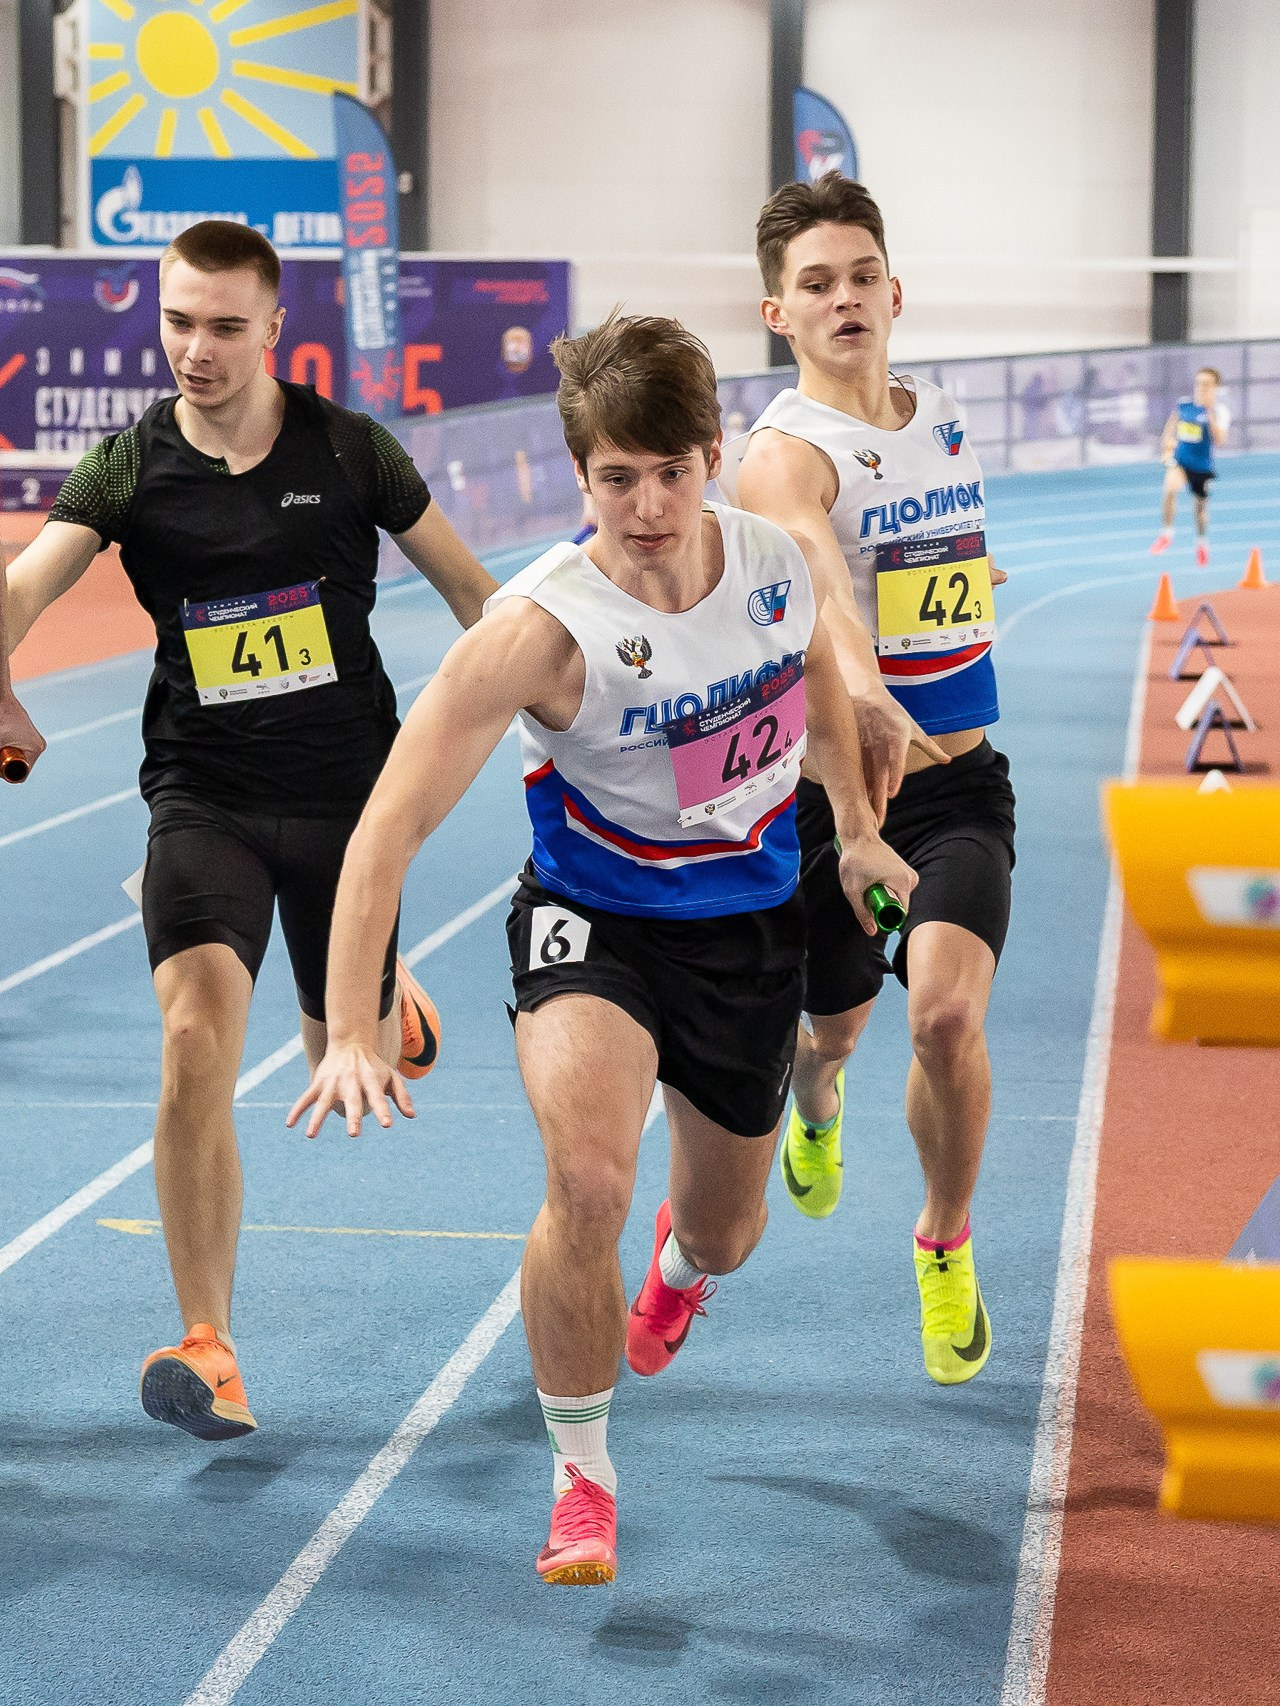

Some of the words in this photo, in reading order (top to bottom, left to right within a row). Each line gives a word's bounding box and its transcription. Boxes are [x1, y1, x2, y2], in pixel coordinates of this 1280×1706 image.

[293, 494, 321, 504] asics
[267, 586, 308, 607] 2025
[918, 571, 972, 626] 42
[974, 600, 982, 620] 3
[231, 624, 290, 678] 41
[298, 648, 312, 666] 3
[761, 664, 795, 699] 2025
[721, 714, 783, 784] 42
[784, 729, 793, 750] 4
[540, 918, 571, 964] 6
